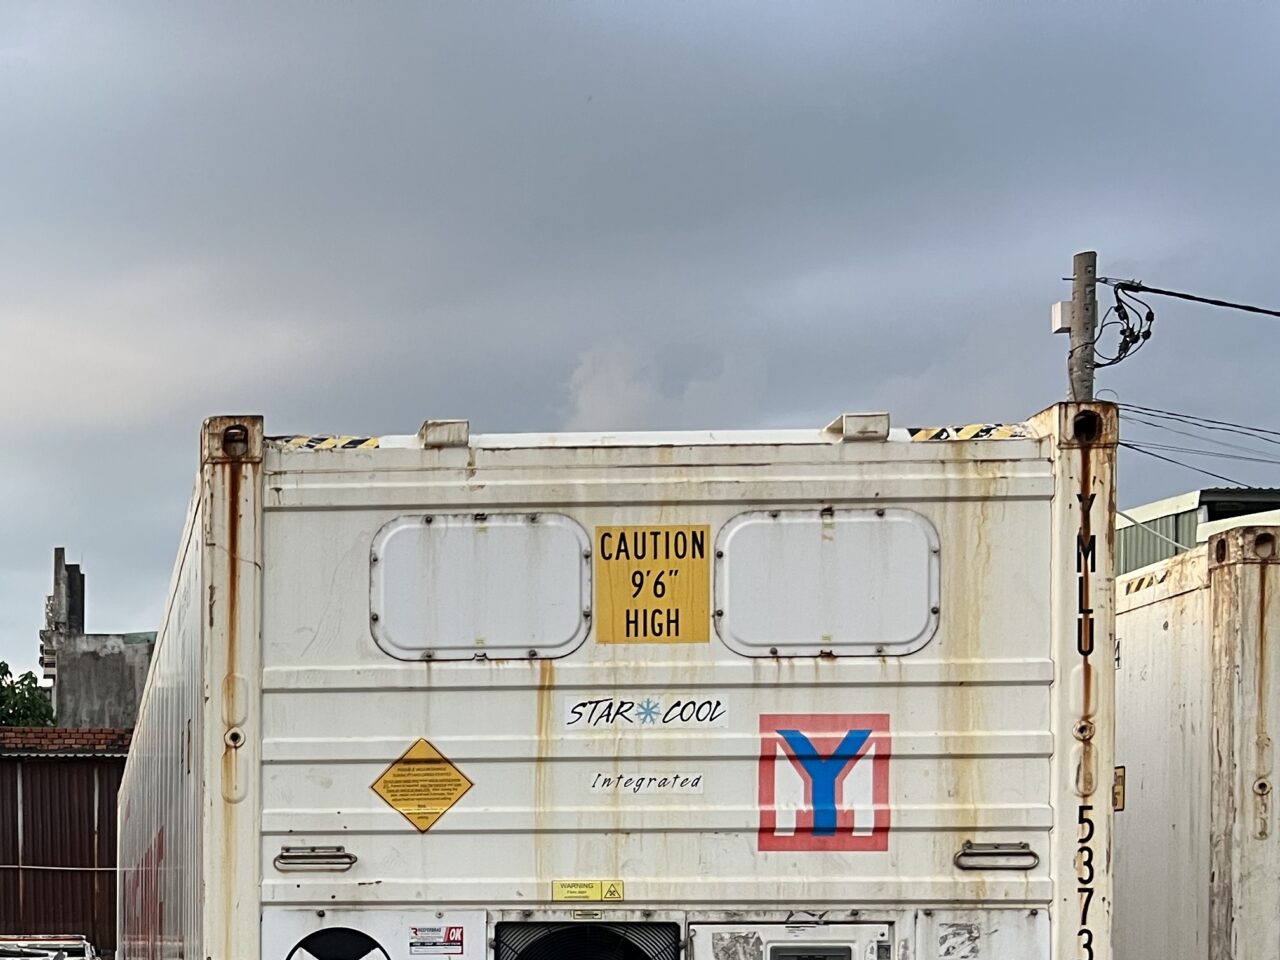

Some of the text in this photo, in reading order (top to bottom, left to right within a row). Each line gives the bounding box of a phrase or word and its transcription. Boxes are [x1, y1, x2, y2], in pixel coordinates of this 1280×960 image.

[600, 530, 705, 560] CAUTION
[631, 569, 679, 599] 9'6"
[1077, 494, 1096, 656] YMLU
[625, 608, 680, 638] HIGH
[566, 698, 726, 726] STAR COOL
[591, 773, 702, 793] Integrated
[449, 927, 463, 941] OK
